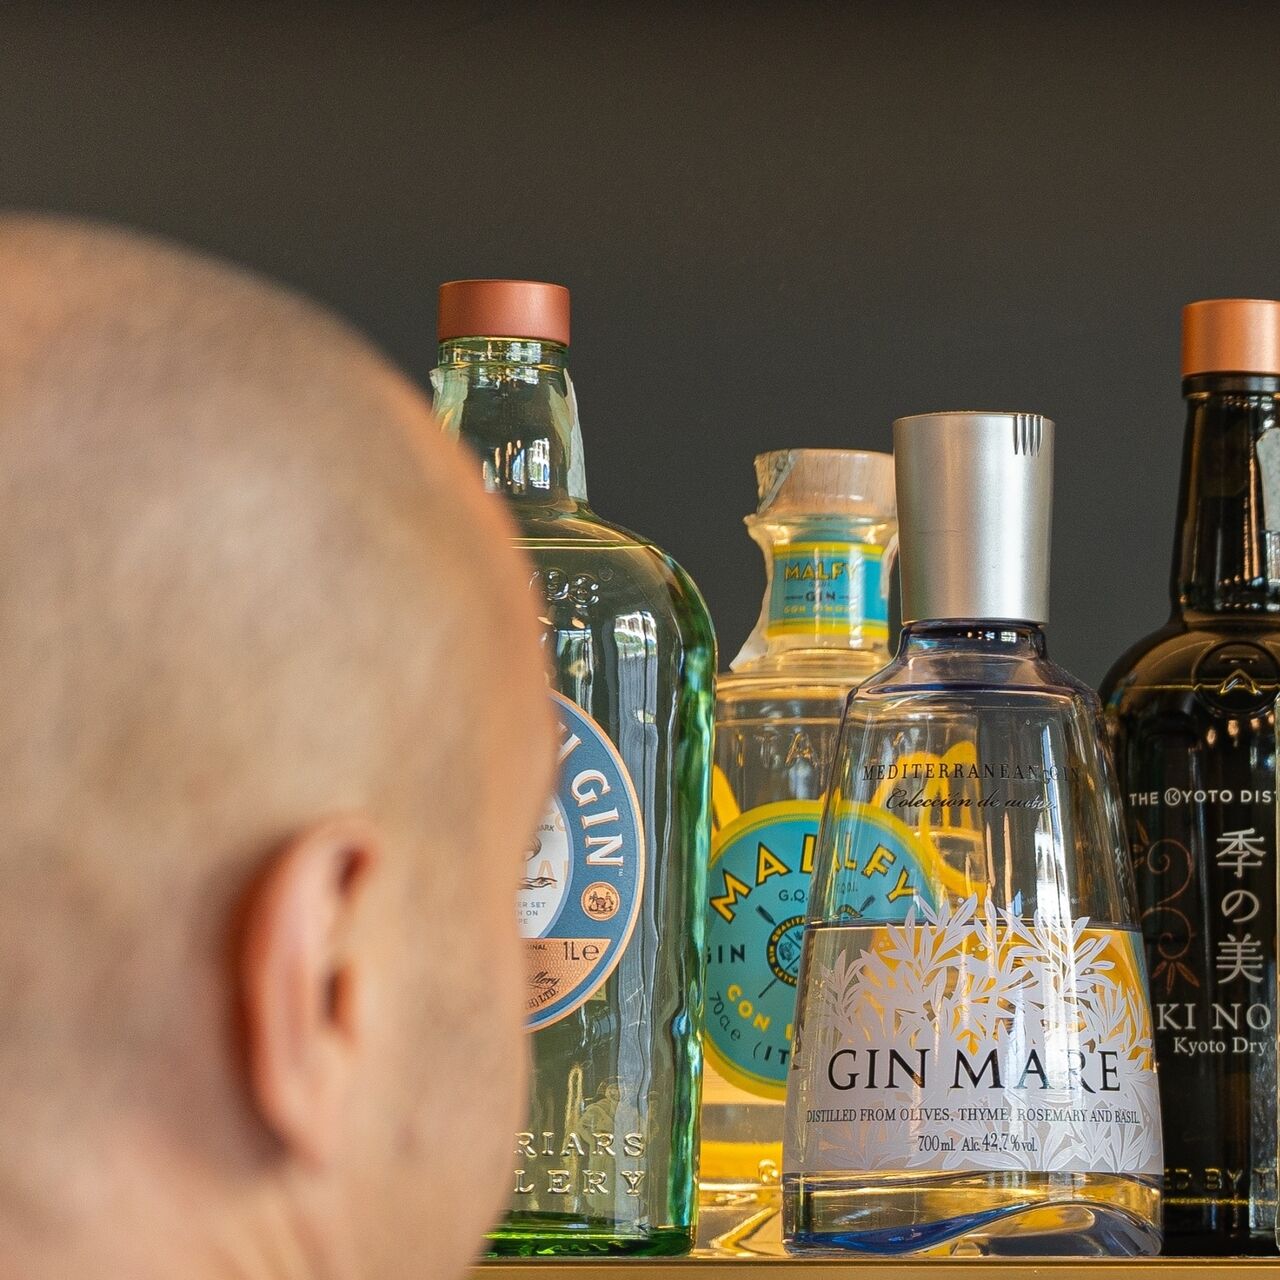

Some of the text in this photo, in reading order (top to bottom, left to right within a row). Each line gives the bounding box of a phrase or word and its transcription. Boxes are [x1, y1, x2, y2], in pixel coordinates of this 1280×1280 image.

[862, 763, 1039, 782] MEDITERRANEAN
[1128, 791, 1159, 807] THE
[570, 768, 624, 867] GIN
[1216, 827, 1267, 986] 季の美
[1156, 1001, 1273, 1032] KI NO
[1173, 1036, 1268, 1057] Kyoto Dry
[827, 1048, 932, 1092] GIN
[949, 1048, 1122, 1094] MARE
[806, 1109, 858, 1123] DISTILLED
[860, 1109, 897, 1122] FROM
[899, 1108, 954, 1122] OLIVES,
[957, 1108, 1013, 1122] THYME,
[1016, 1109, 1088, 1122] ROSEMARY
[1090, 1110, 1113, 1123] AND
